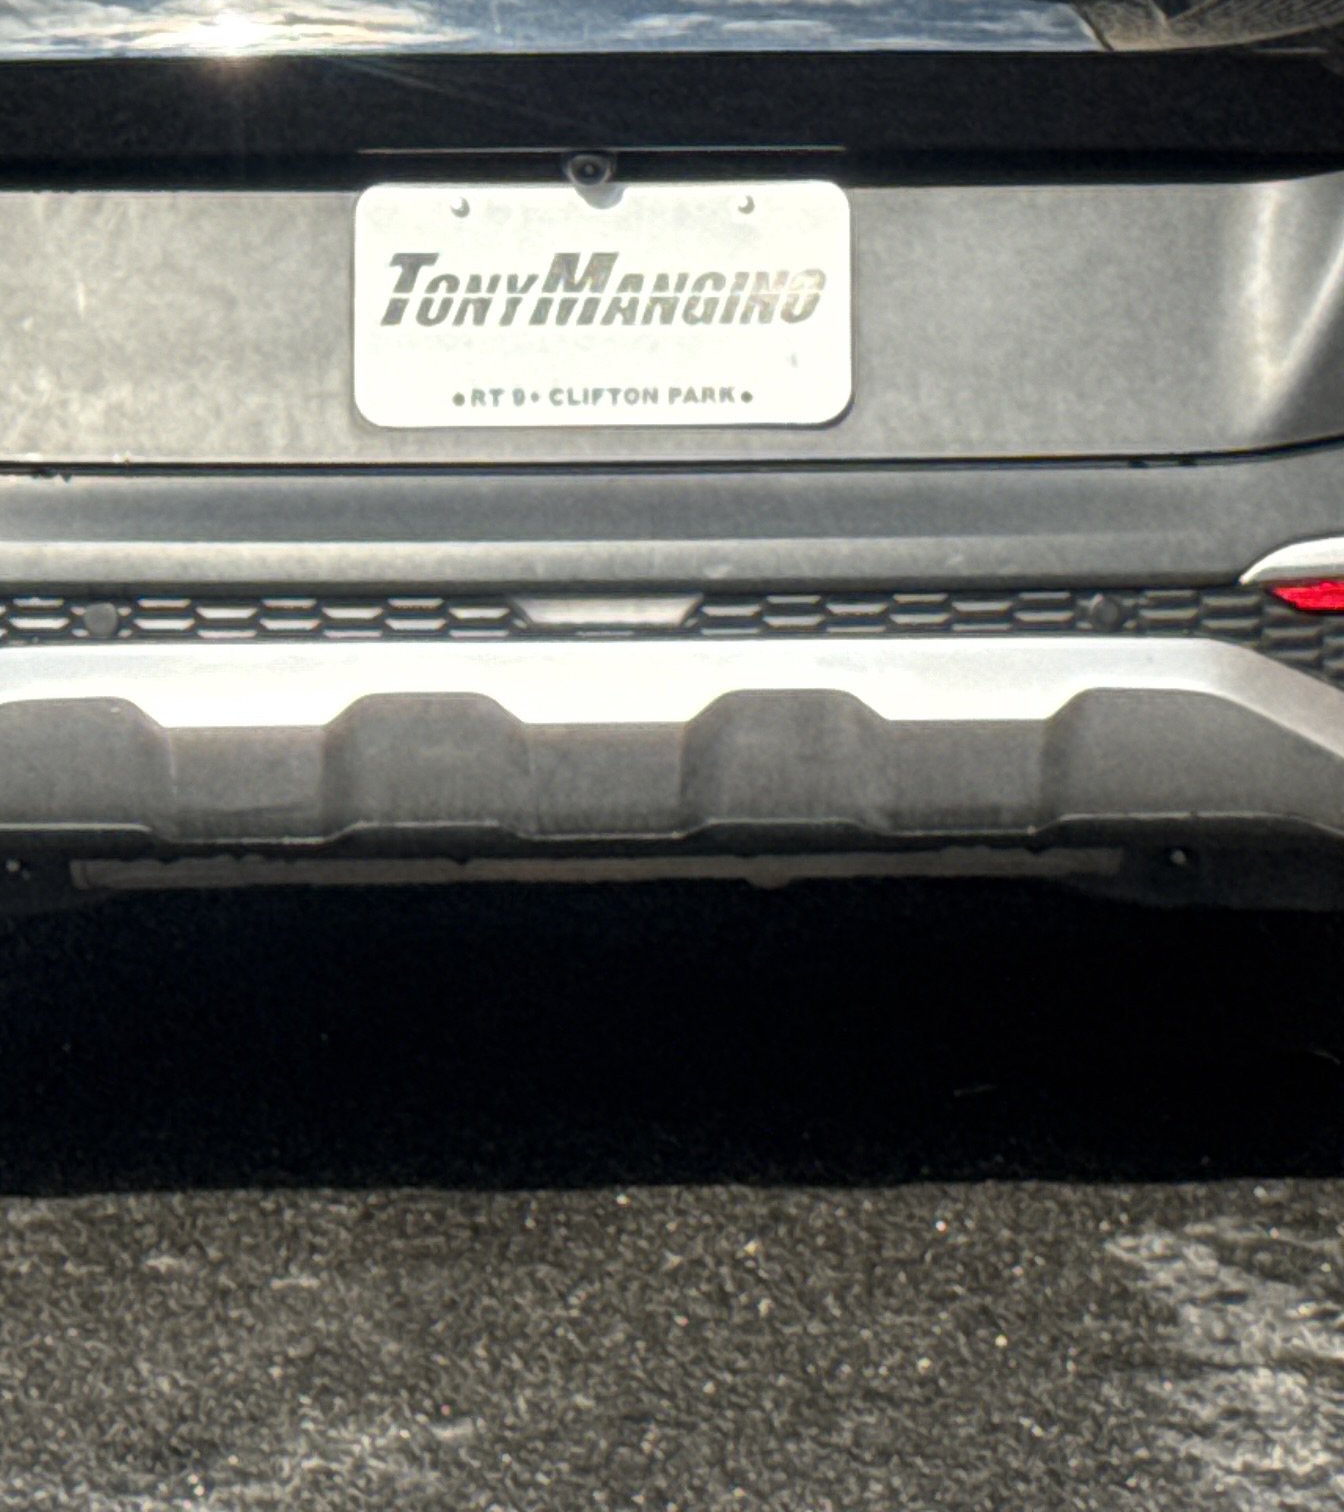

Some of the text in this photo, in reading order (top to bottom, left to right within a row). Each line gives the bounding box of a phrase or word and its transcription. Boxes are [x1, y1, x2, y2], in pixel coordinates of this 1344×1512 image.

[470, 387, 505, 407] RT
[549, 387, 659, 407] CLIFTON
[668, 385, 736, 406] PARK
